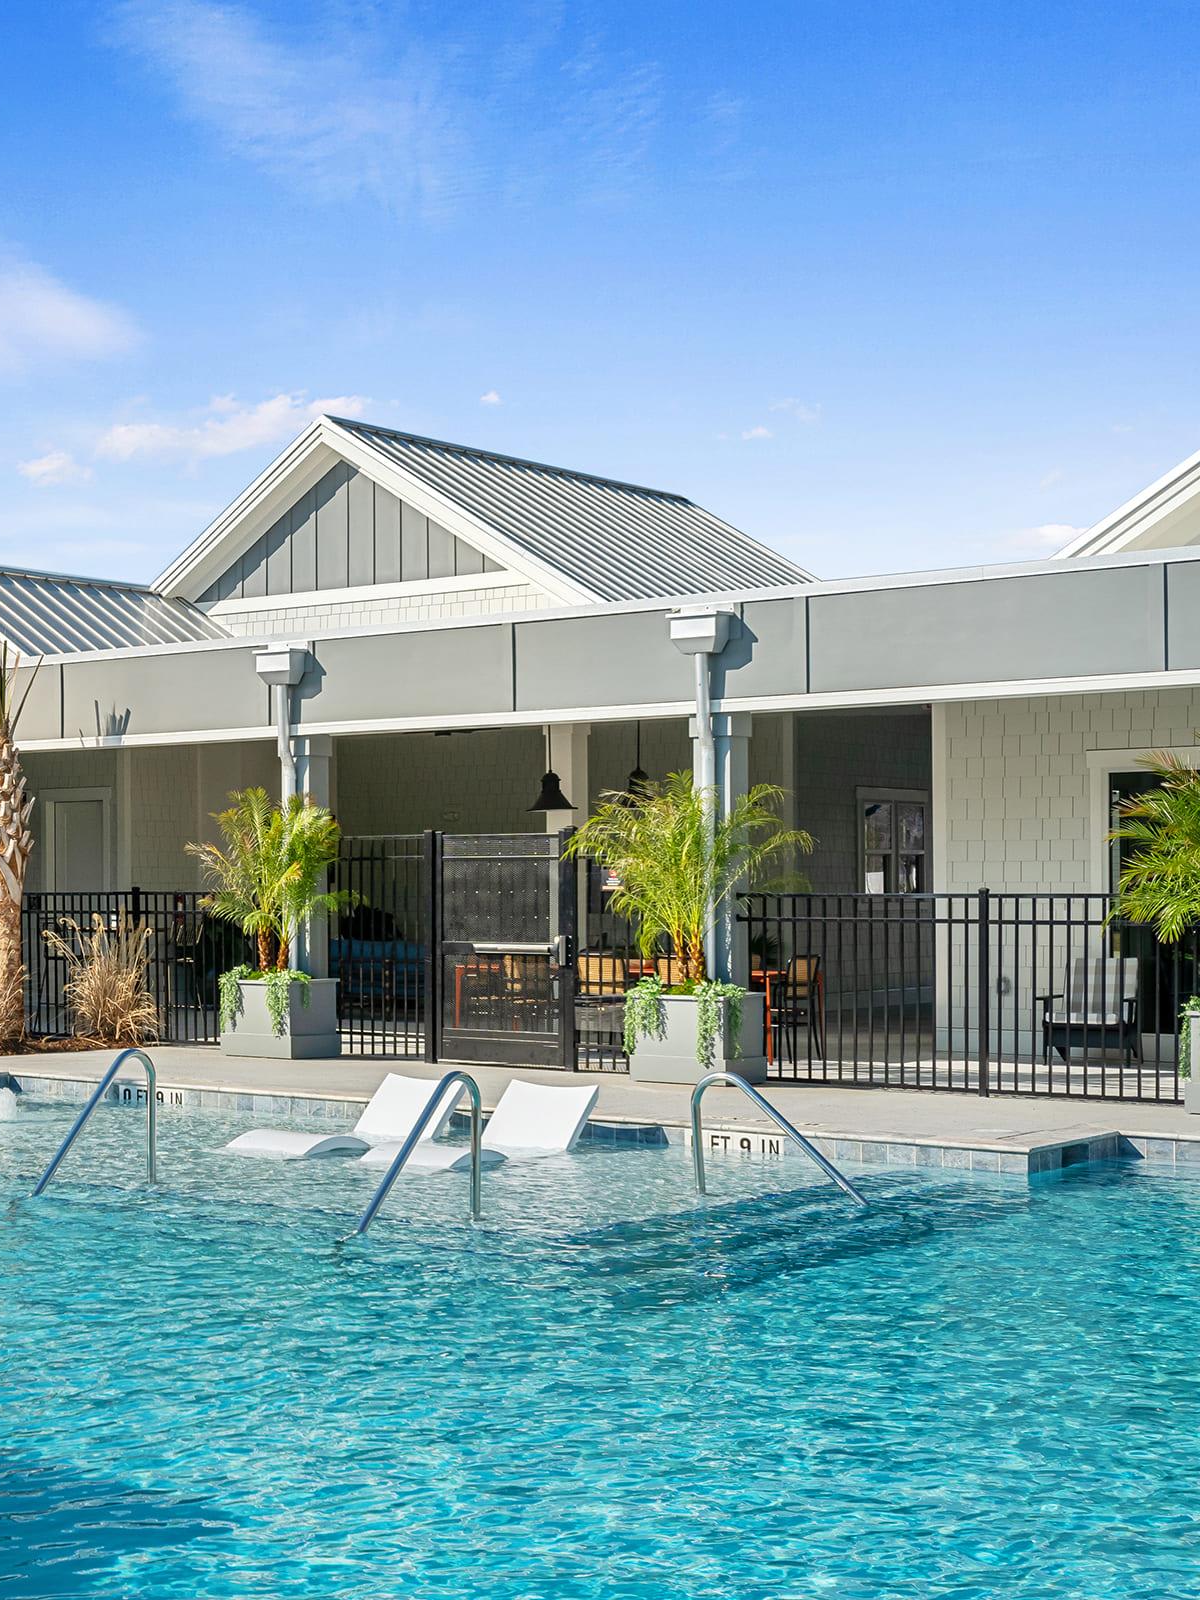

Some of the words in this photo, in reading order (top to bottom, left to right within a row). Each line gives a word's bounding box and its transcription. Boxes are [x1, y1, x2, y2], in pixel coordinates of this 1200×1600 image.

[156, 1091, 164, 1103] 9
[170, 1092, 183, 1104] IN
[710, 1135, 731, 1150] FT
[739, 1137, 751, 1152] 9
[761, 1139, 780, 1154] IN
